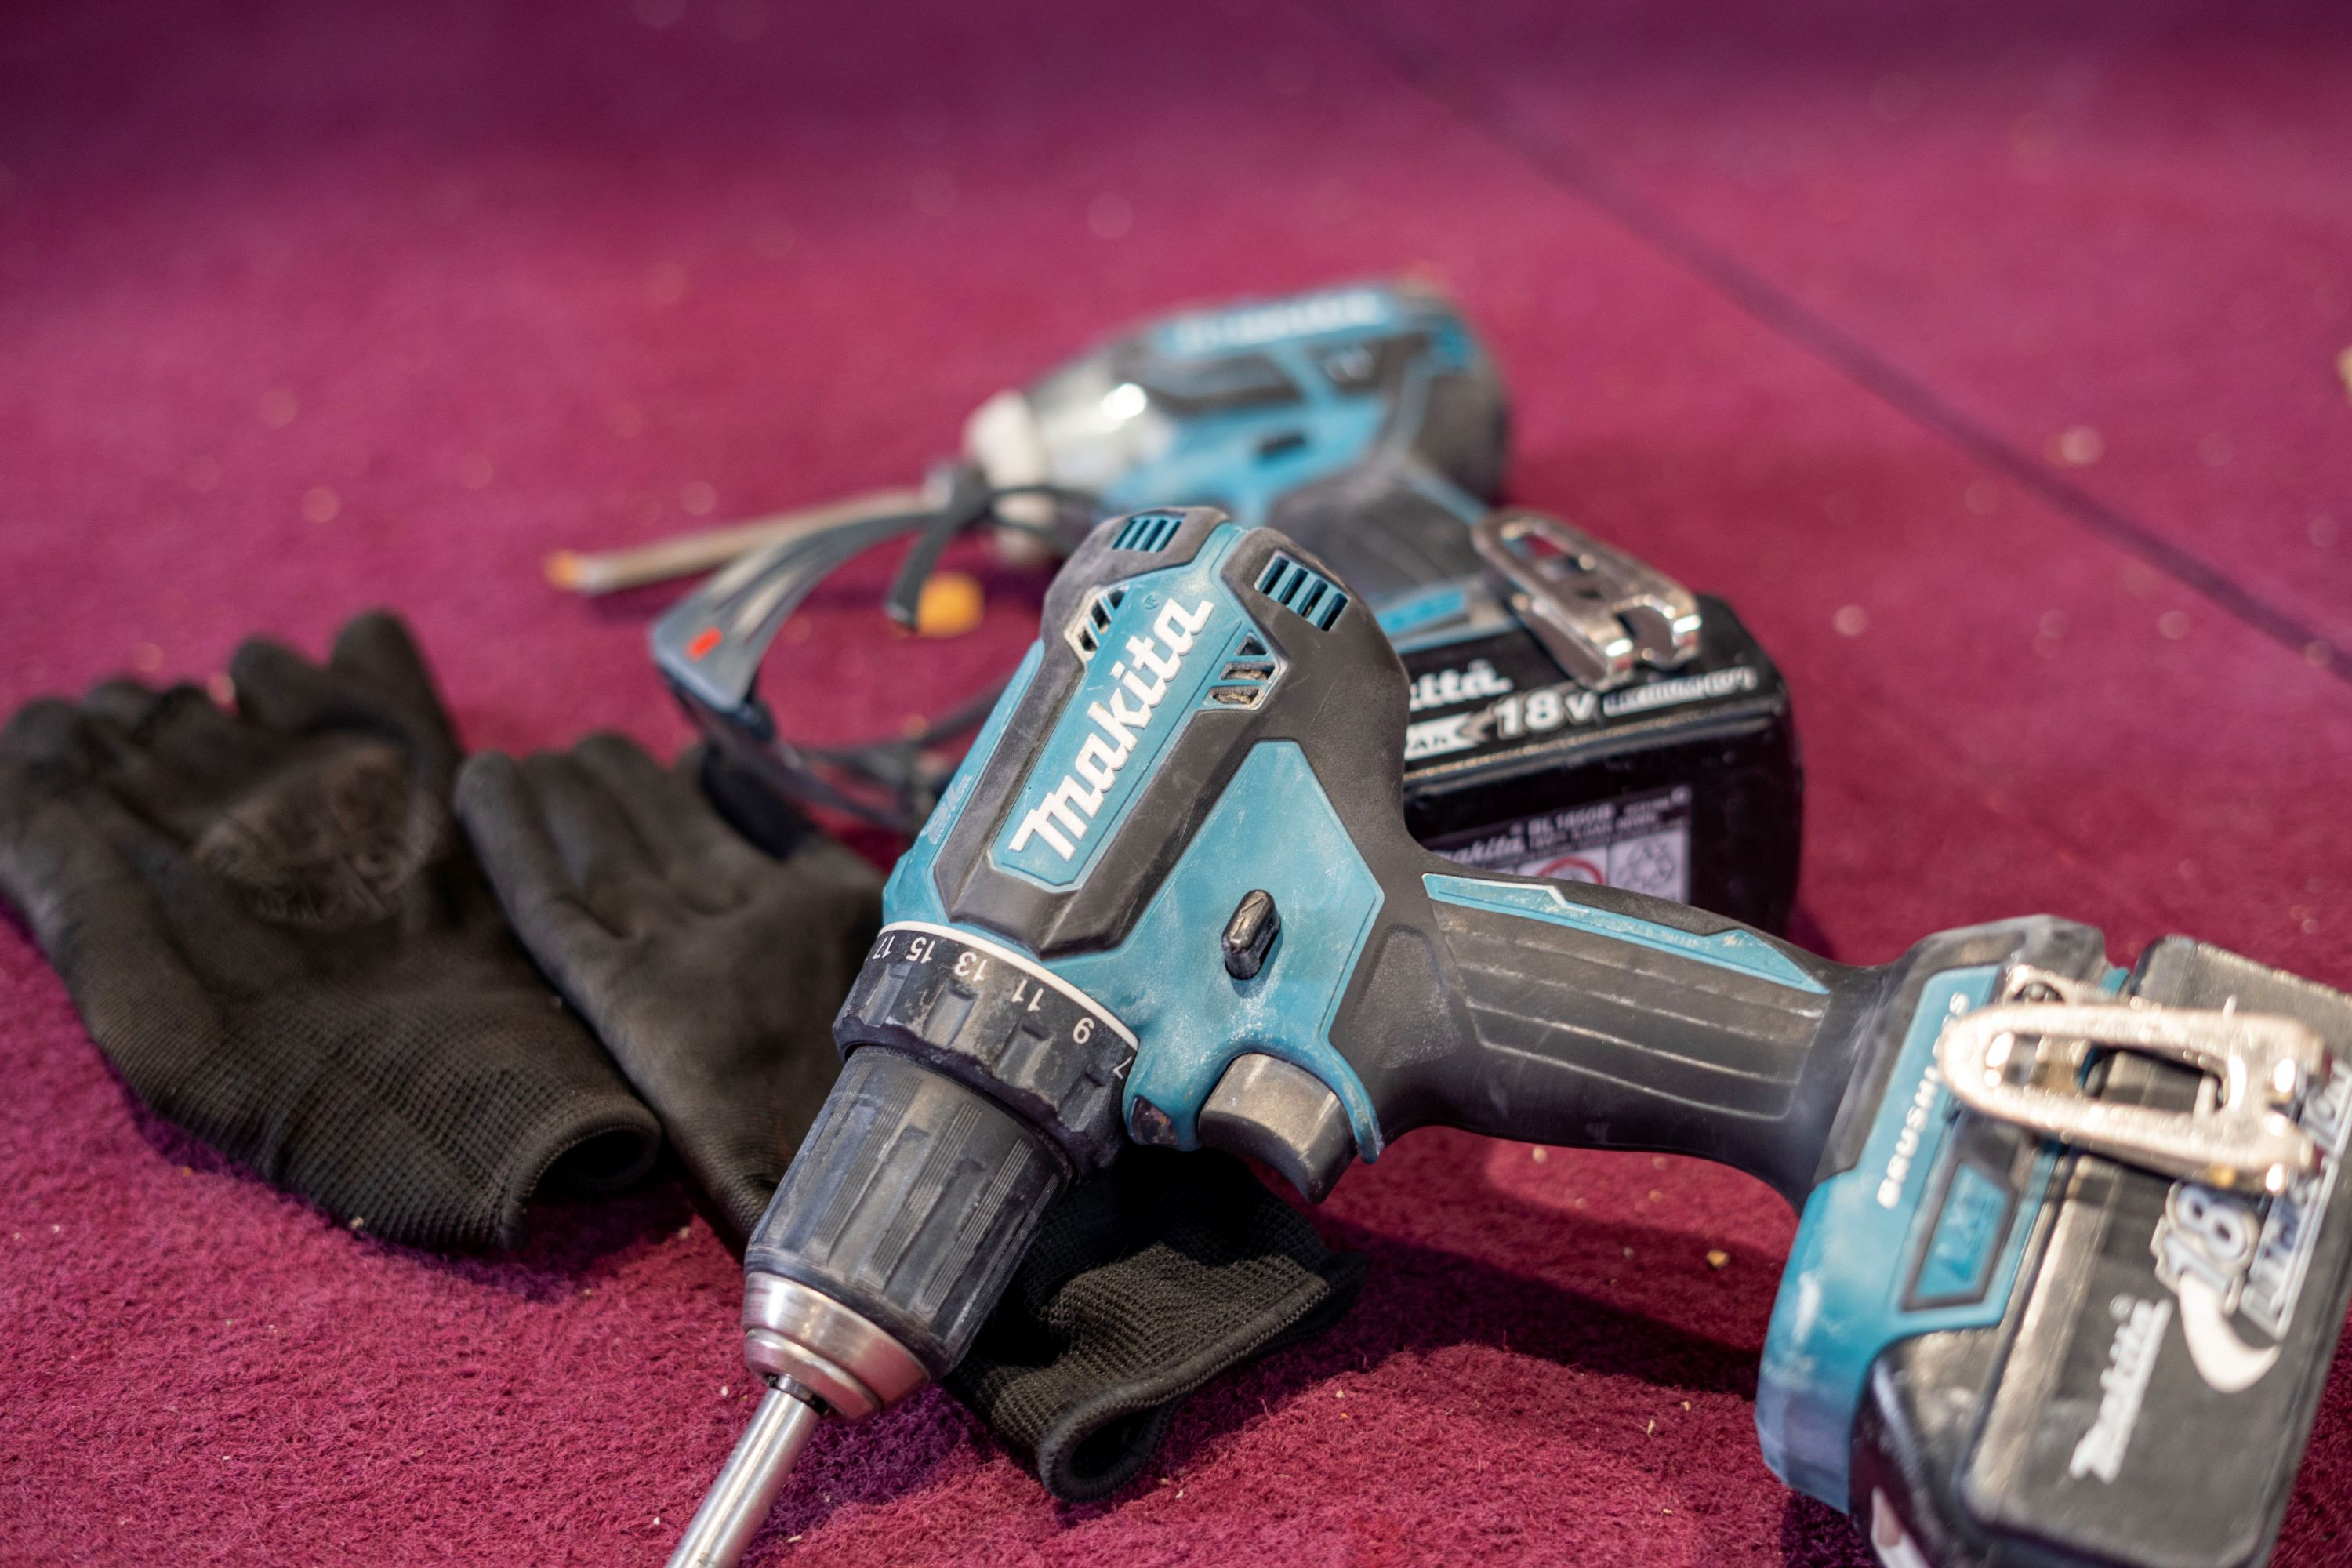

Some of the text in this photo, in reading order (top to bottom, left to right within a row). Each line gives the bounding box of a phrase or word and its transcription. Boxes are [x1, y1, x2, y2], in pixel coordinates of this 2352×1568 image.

[872, 934, 1133, 1080] 7 9 11 13 15 17
